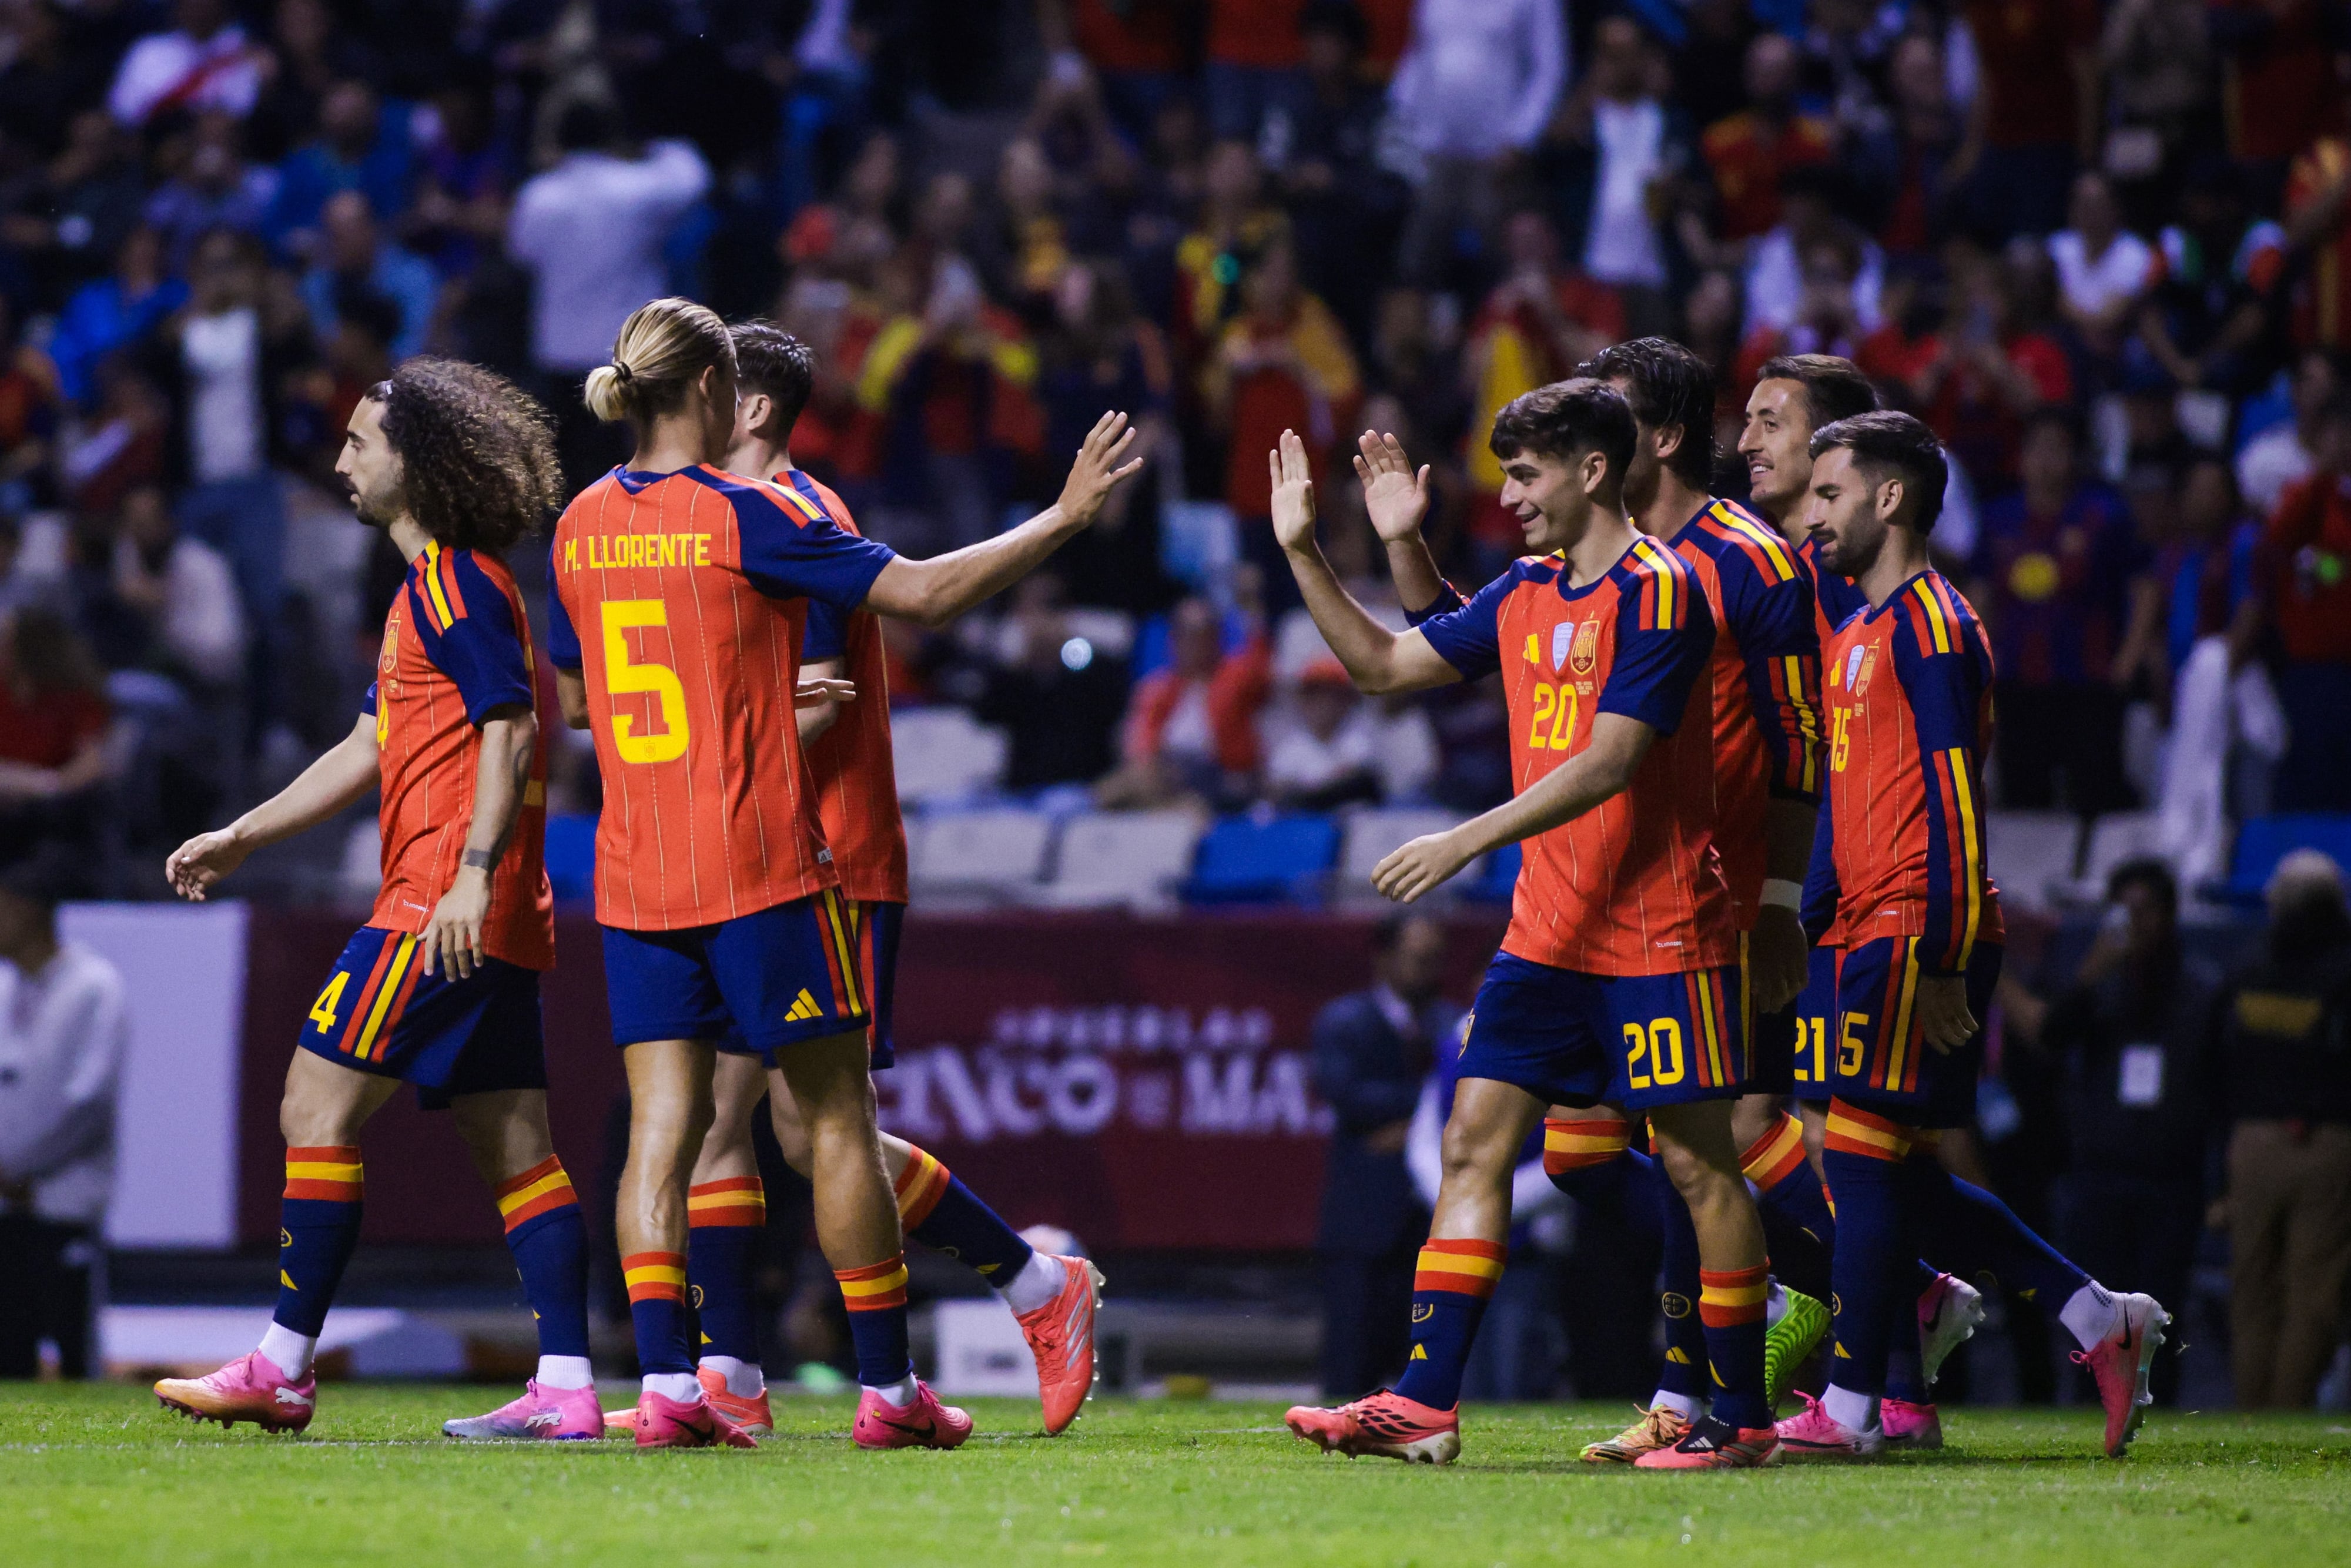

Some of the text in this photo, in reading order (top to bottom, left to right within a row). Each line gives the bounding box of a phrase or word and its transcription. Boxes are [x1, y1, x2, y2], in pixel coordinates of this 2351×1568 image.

[565, 534, 712, 574] M. LLORENTE
[601, 598, 690, 763] 5
[1529, 682, 1578, 751] 20
[309, 970, 350, 1034] 4
[1623, 1017, 1684, 1089] 20
